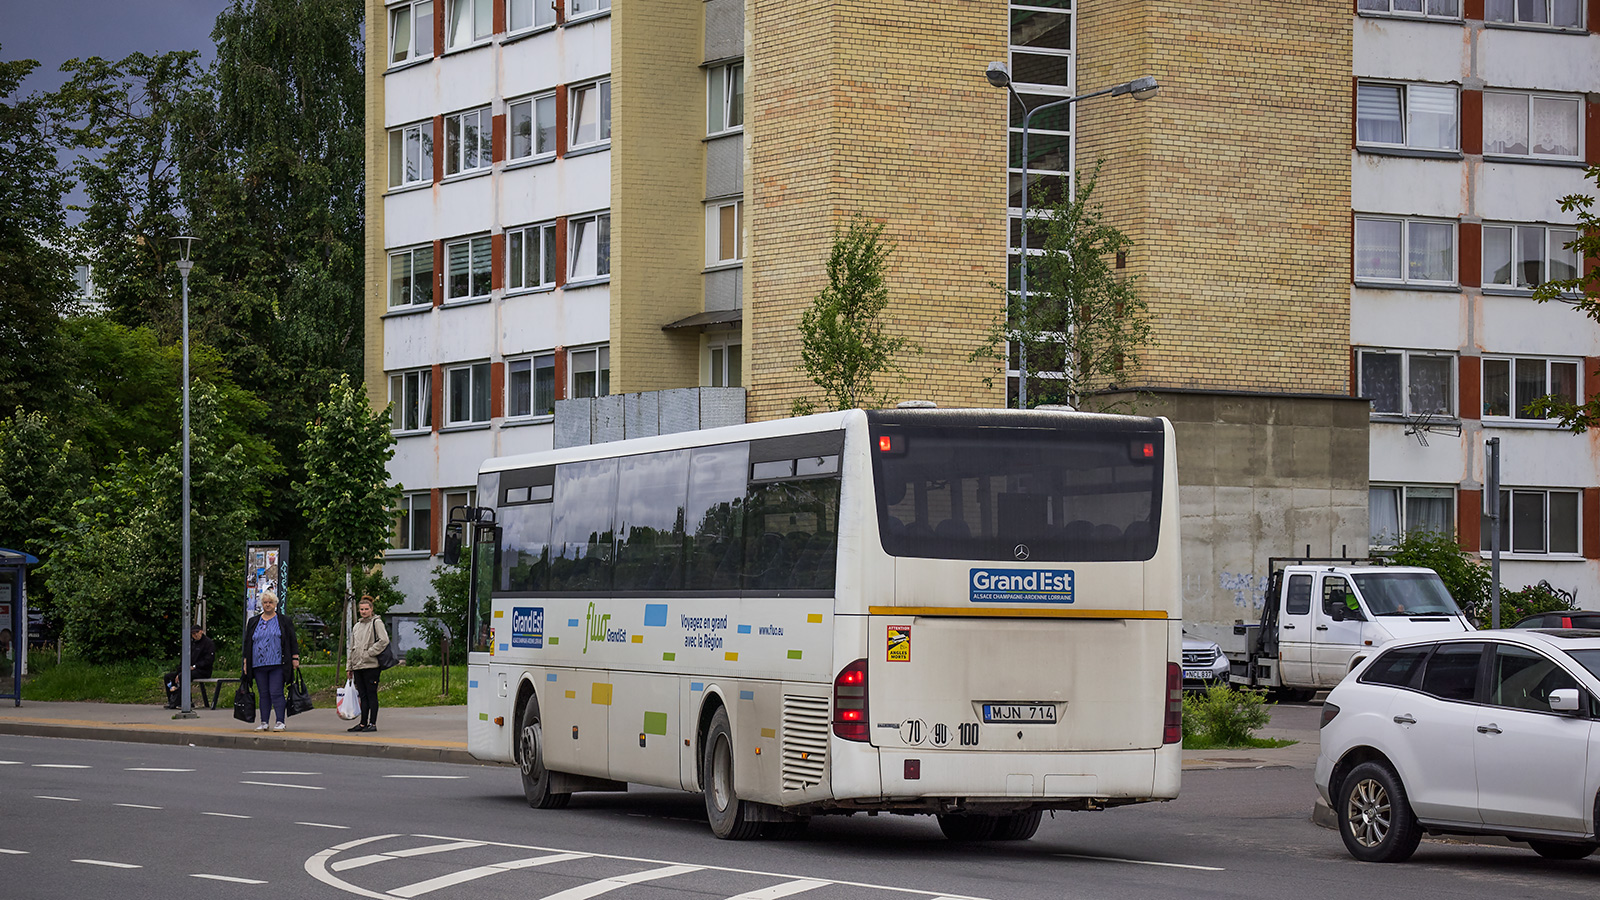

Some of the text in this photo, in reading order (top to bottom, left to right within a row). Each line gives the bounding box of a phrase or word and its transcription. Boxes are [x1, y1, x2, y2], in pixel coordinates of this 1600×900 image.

[680, 614, 728, 632] Voyagez en grand
[684, 633, 723, 651] avec la Région
[992, 706, 1053, 719] MJN 714
[907, 720, 920, 742] 70
[935, 723, 947, 744] 90
[958, 723, 979, 745] 100
